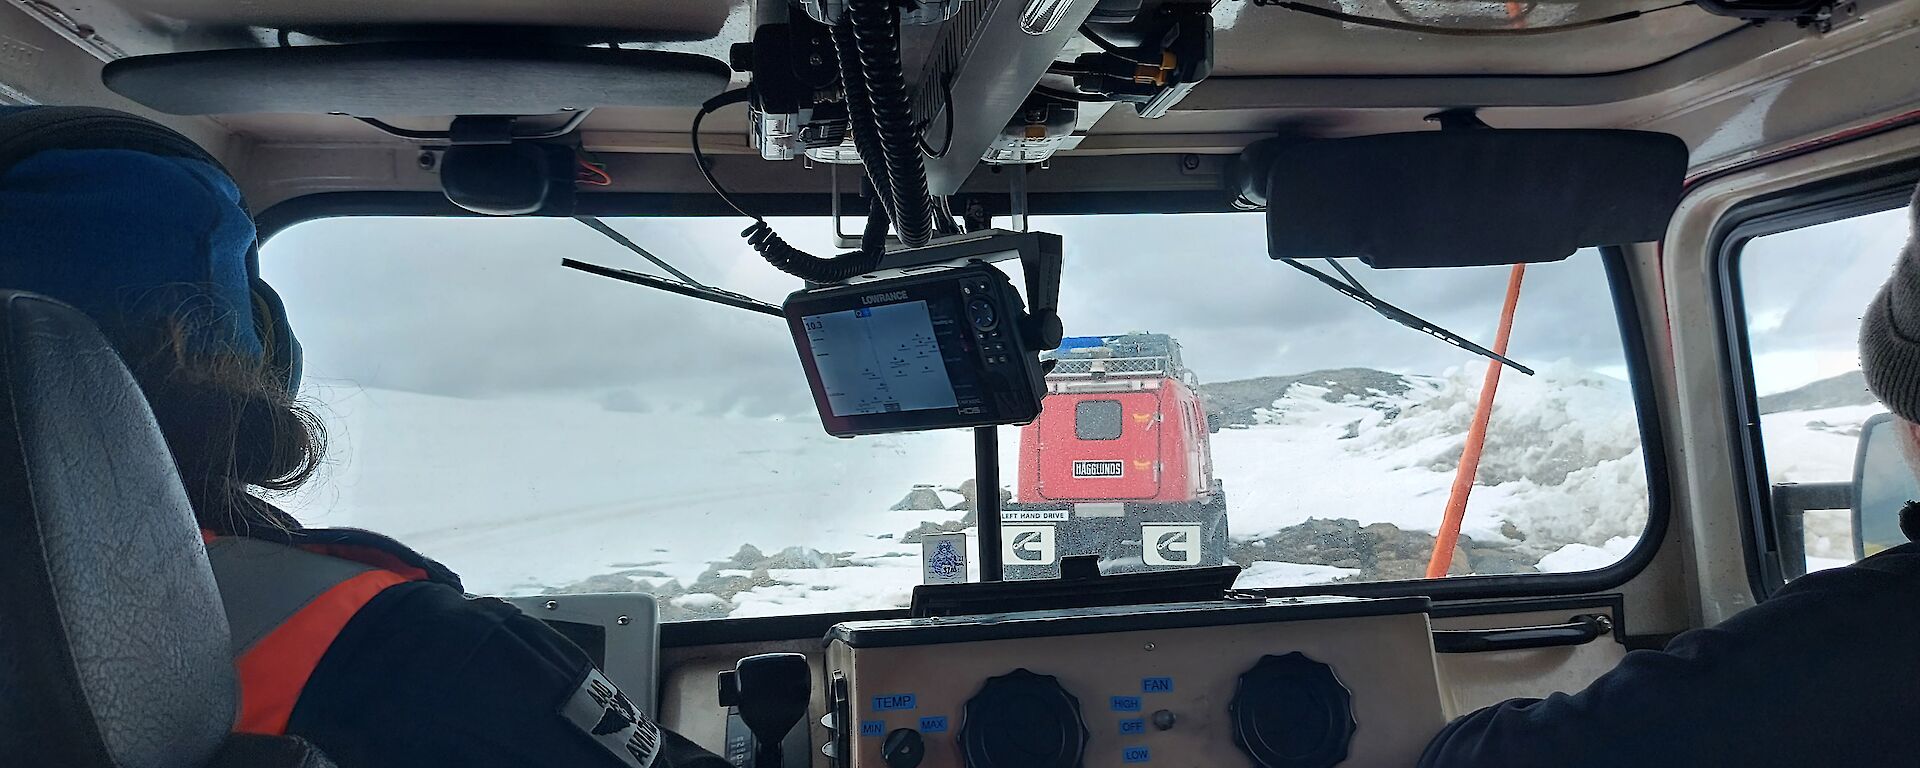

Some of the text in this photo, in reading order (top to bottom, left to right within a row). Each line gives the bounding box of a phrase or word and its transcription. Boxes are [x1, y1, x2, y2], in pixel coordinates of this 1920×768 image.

[861, 290, 908, 305] LOWRANCE
[805, 320, 823, 331] 10.3
[1143, 679, 1169, 691] FAN
[875, 695, 912, 709] TEMP
[1113, 699, 1138, 709] HIGH
[862, 724, 882, 734] MIN
[920, 718, 944, 730] MAX
[1122, 722, 1143, 732] OFF
[1126, 750, 1149, 760] LOW
